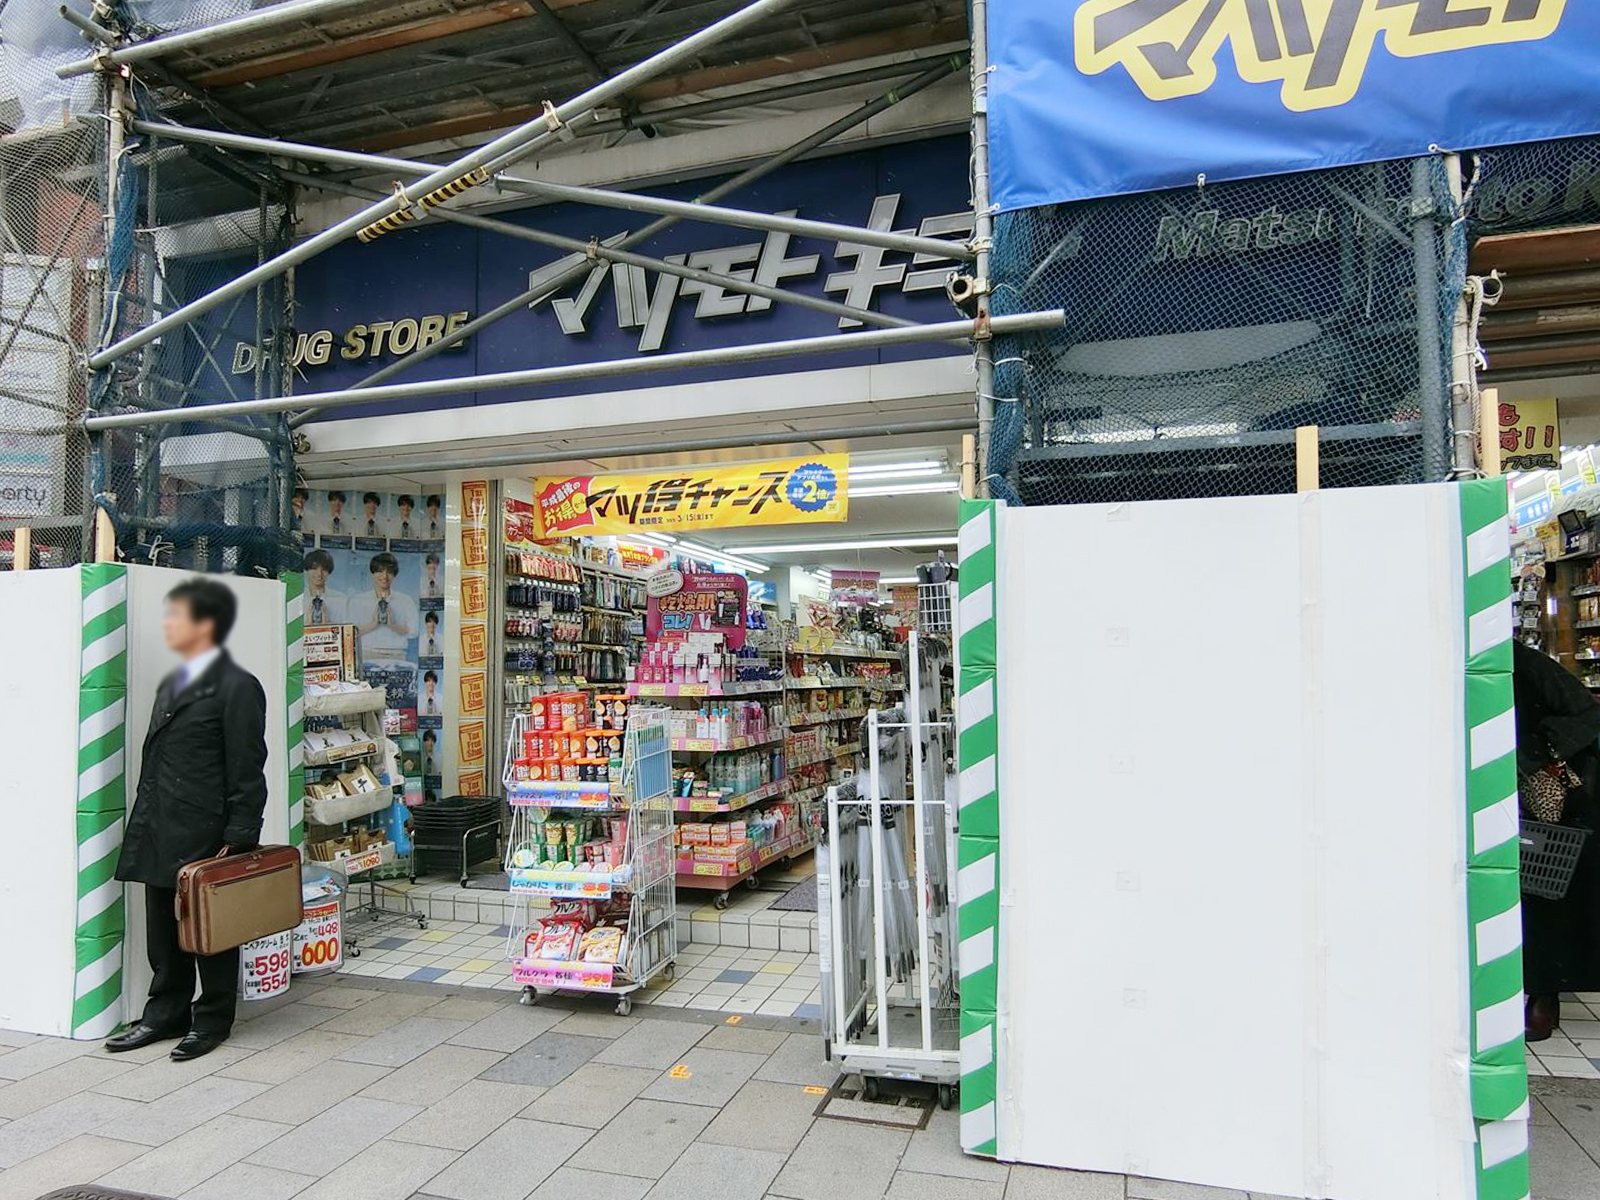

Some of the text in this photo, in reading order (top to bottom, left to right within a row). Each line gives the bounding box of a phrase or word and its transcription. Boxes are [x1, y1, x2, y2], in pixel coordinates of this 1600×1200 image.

[340, 311, 469, 360] STORE
[585, 470, 790, 524] マツ得チャンス
[469, 683, 480, 691] Tax
[468, 732, 480, 740] Tax
[317, 921, 338, 937] 498
[255, 949, 289, 976] 598
[301, 936, 339, 967] 600
[261, 970, 288, 993] 554
